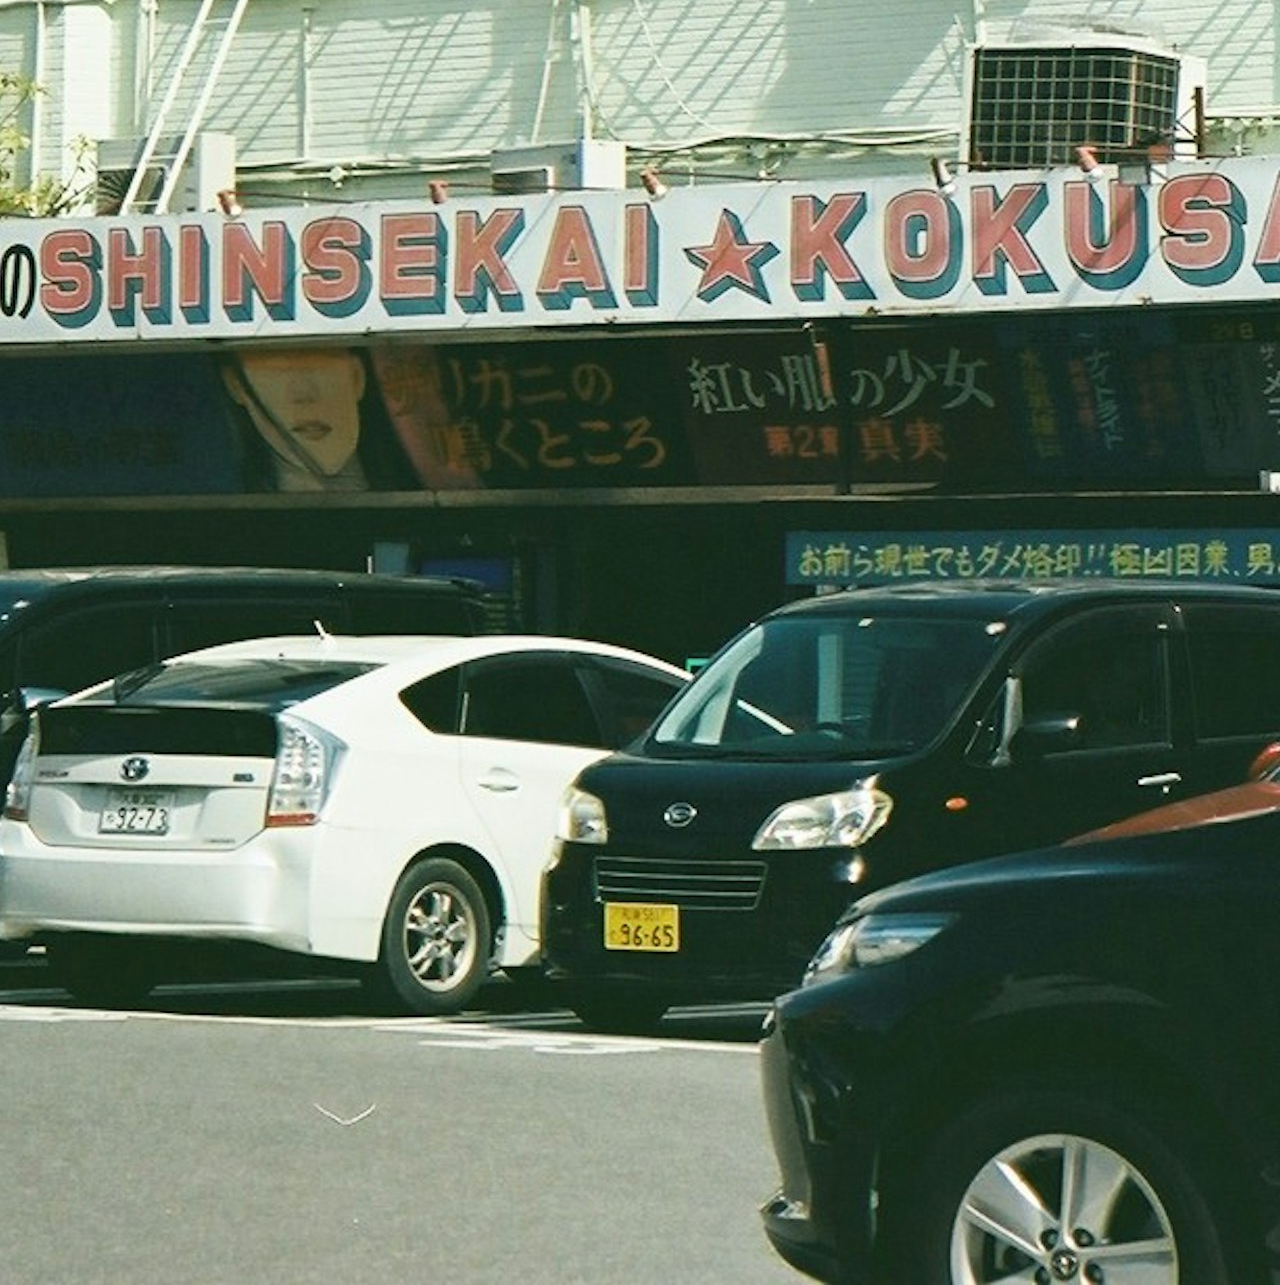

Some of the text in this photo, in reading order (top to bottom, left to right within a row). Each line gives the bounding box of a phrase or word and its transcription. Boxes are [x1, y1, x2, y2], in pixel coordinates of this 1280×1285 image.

[39, 203, 660, 329] SHINSEKAI
[116, 807, 167, 829] 92-73
[620, 923, 673, 947] 96-65
